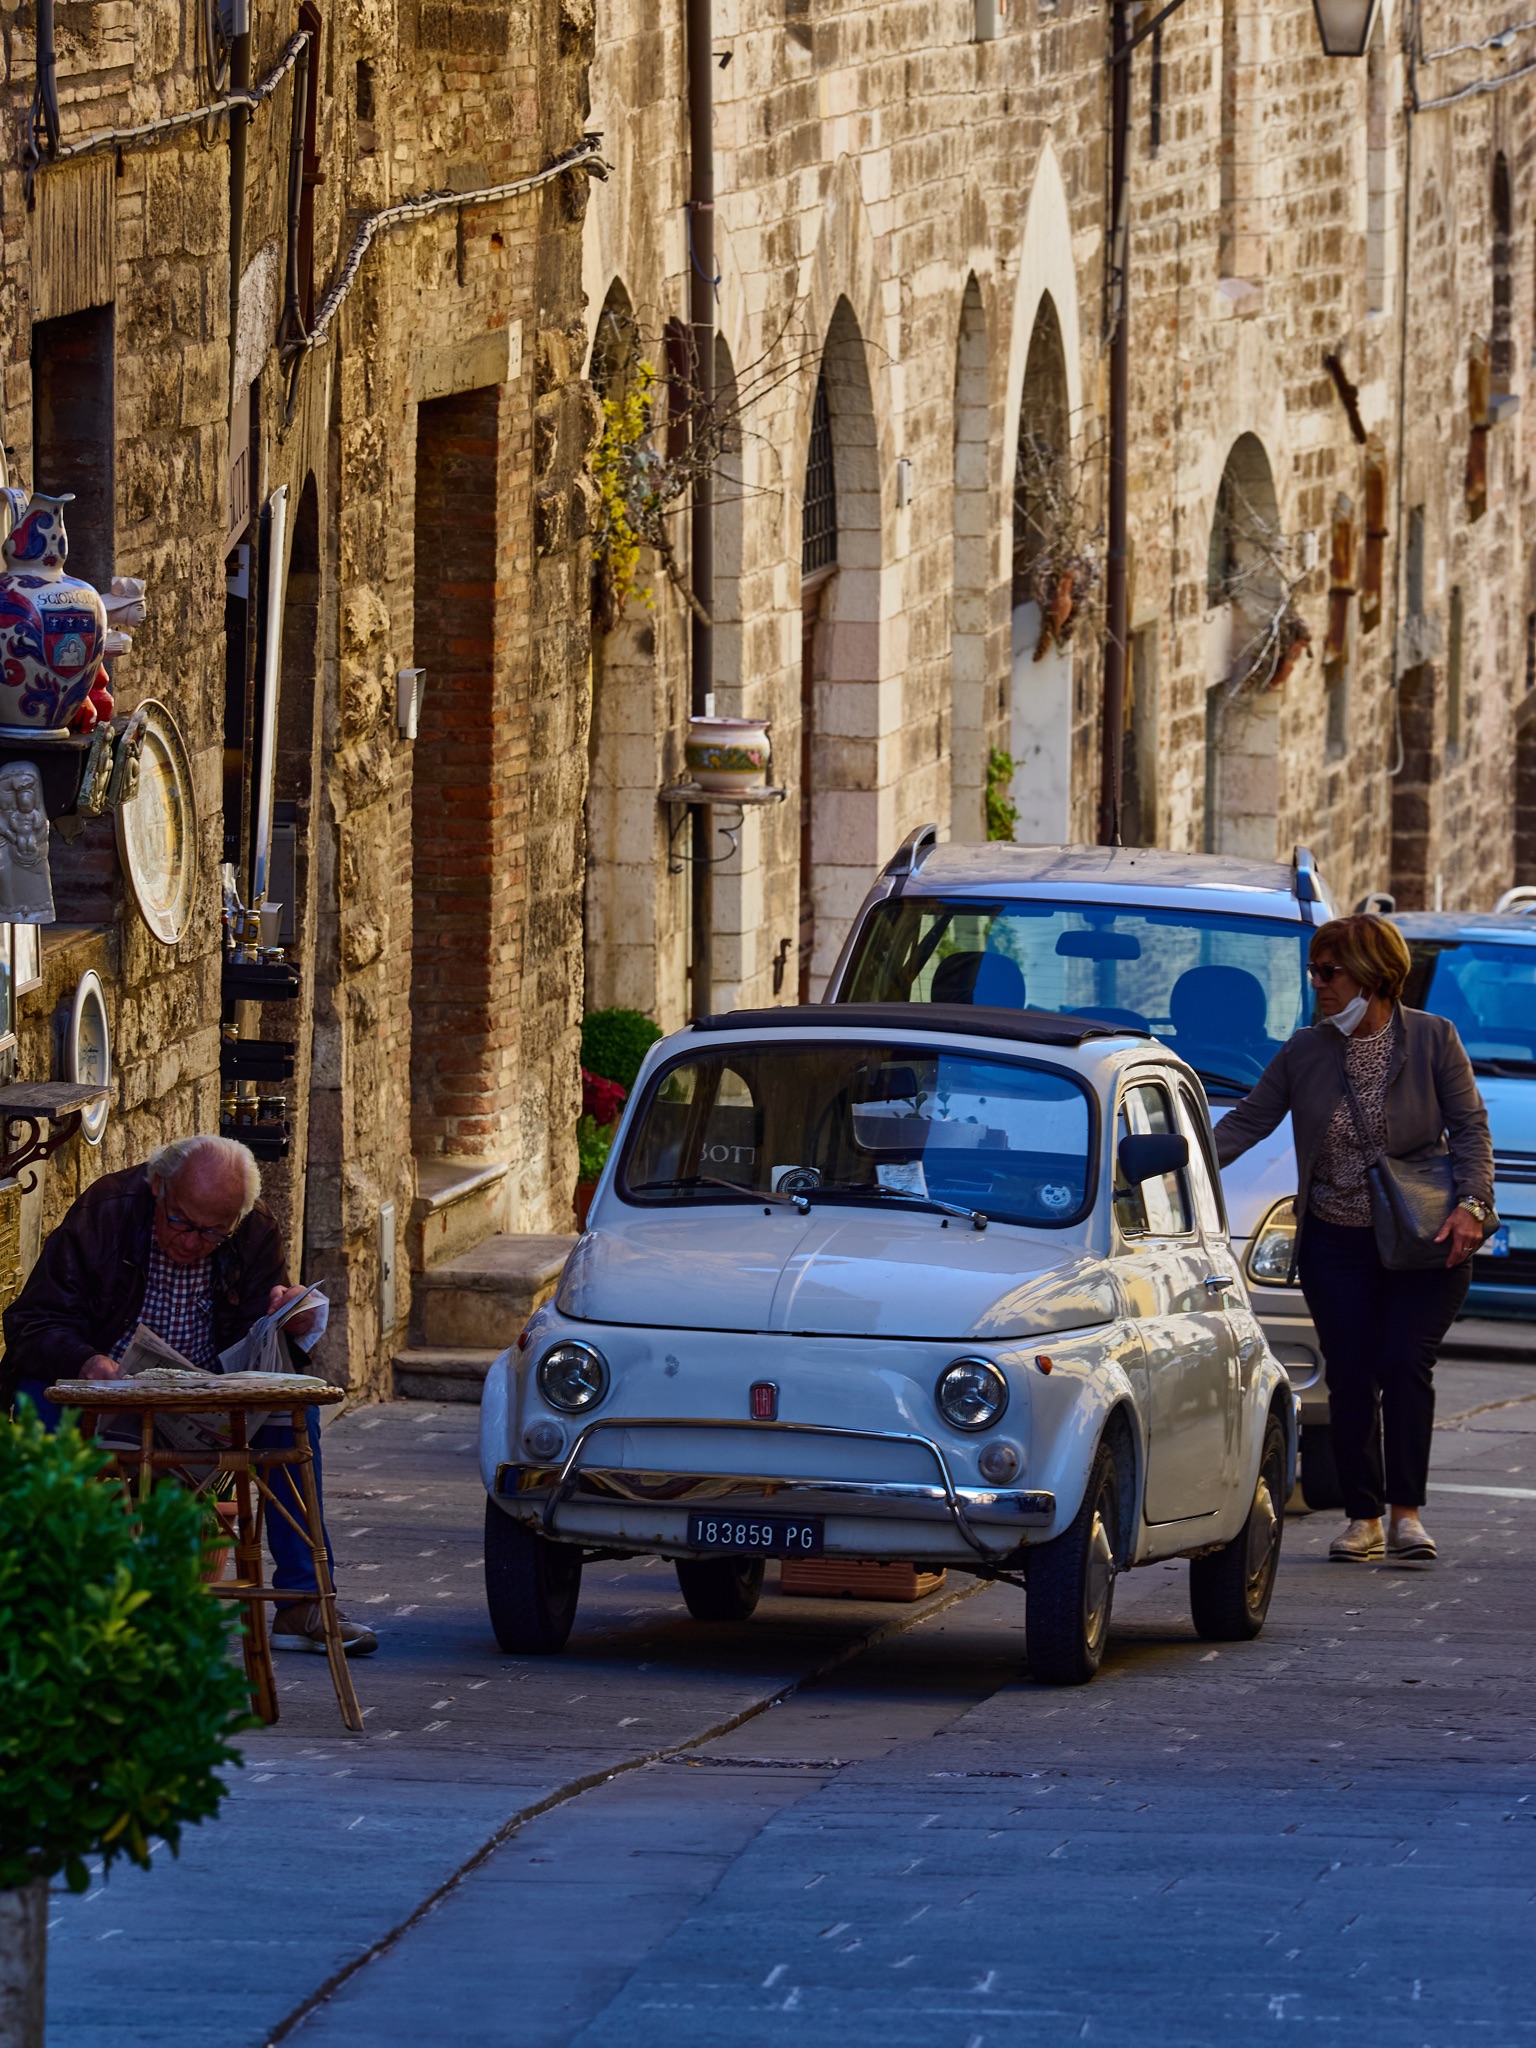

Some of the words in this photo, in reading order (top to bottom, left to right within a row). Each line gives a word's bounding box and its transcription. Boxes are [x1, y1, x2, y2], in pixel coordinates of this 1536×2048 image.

[755, 1388, 772, 1415] FIAT
[697, 1520, 773, 1546] 183859
[786, 1527, 813, 1549] PG
